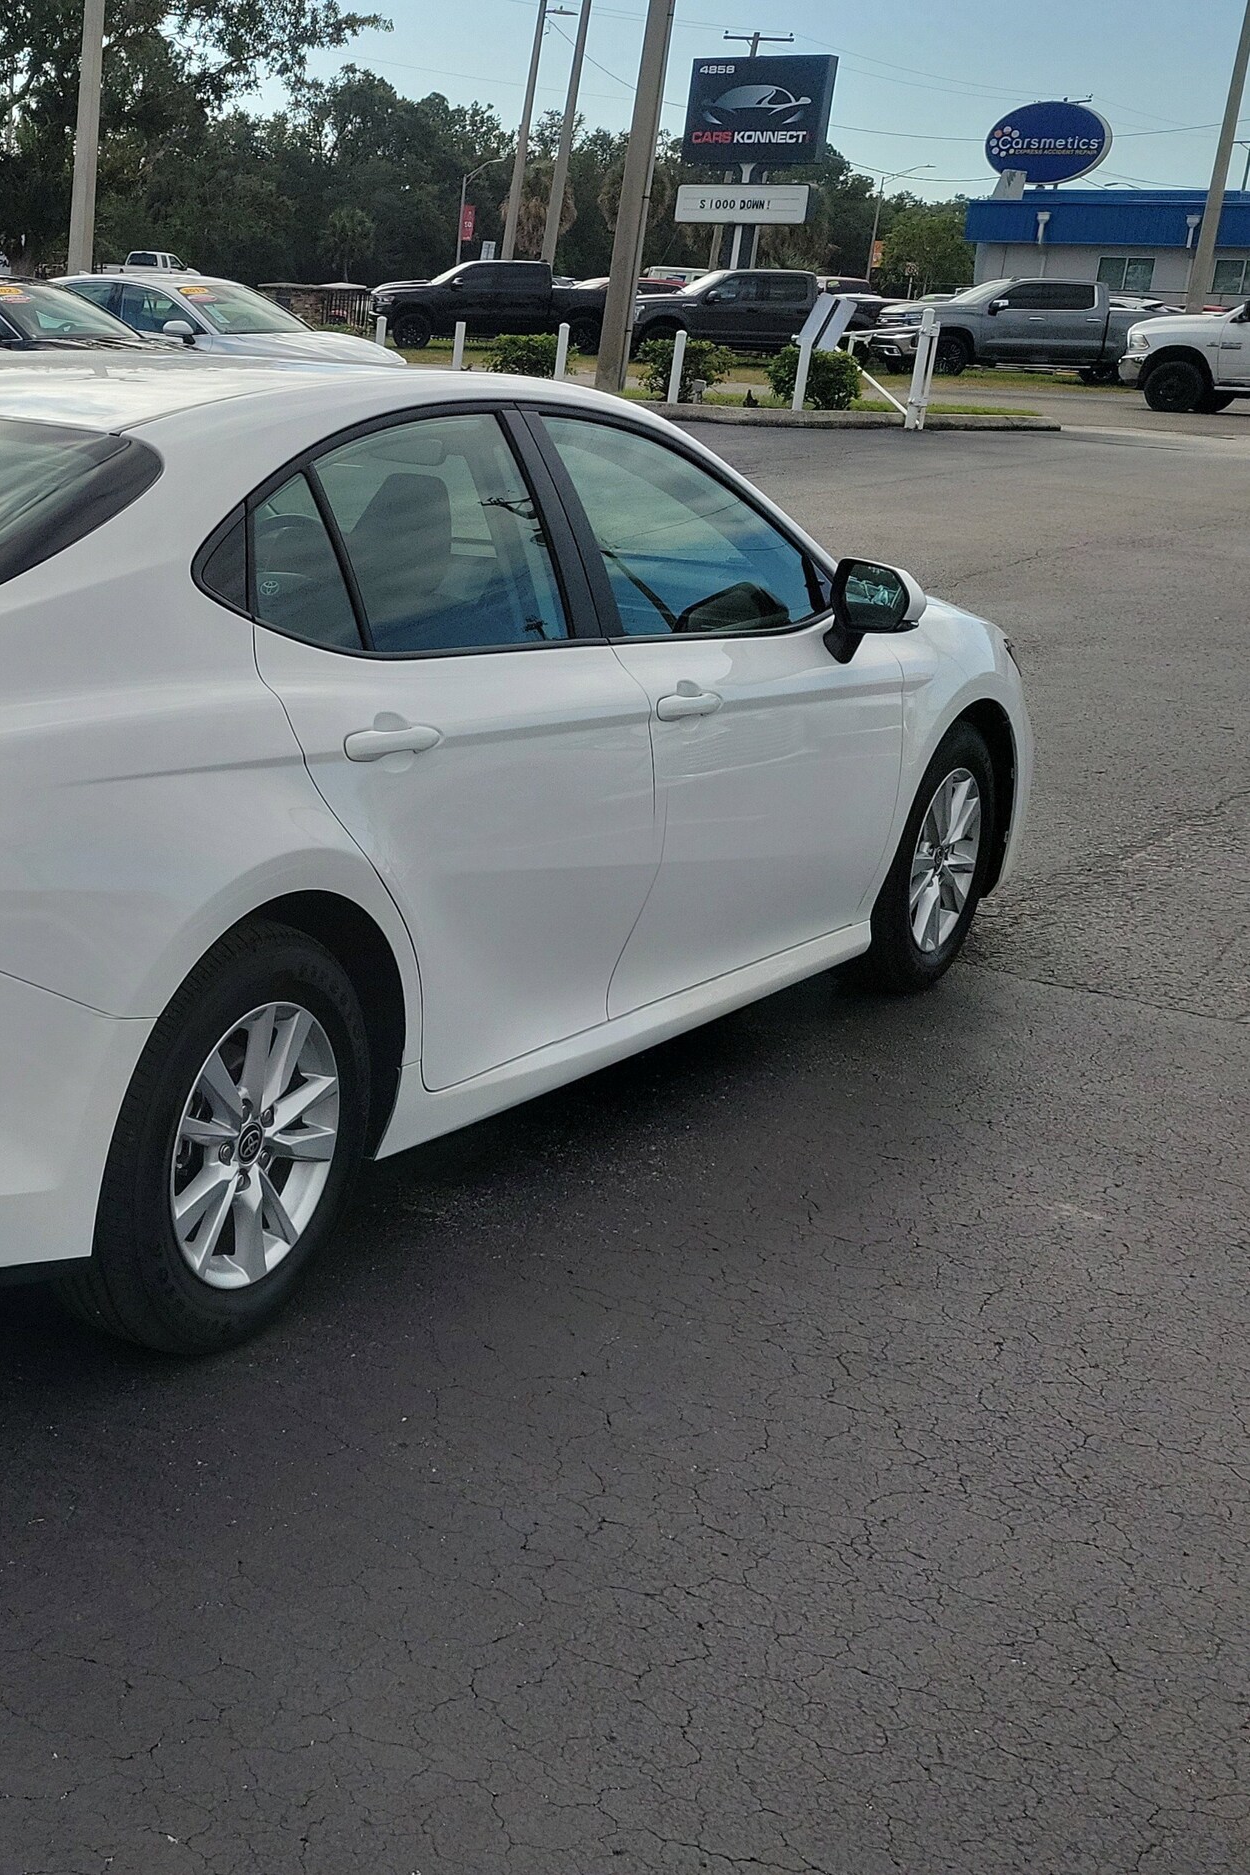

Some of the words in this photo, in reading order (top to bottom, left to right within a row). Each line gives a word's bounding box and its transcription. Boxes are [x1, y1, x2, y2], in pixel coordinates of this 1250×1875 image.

[700, 65, 735, 74] 4858
[692, 131, 732, 144] CARS
[733, 131, 806, 144] KONNECT
[999, 136, 1098, 149] Carsmetics
[740, 199, 770, 210] DOWN!
